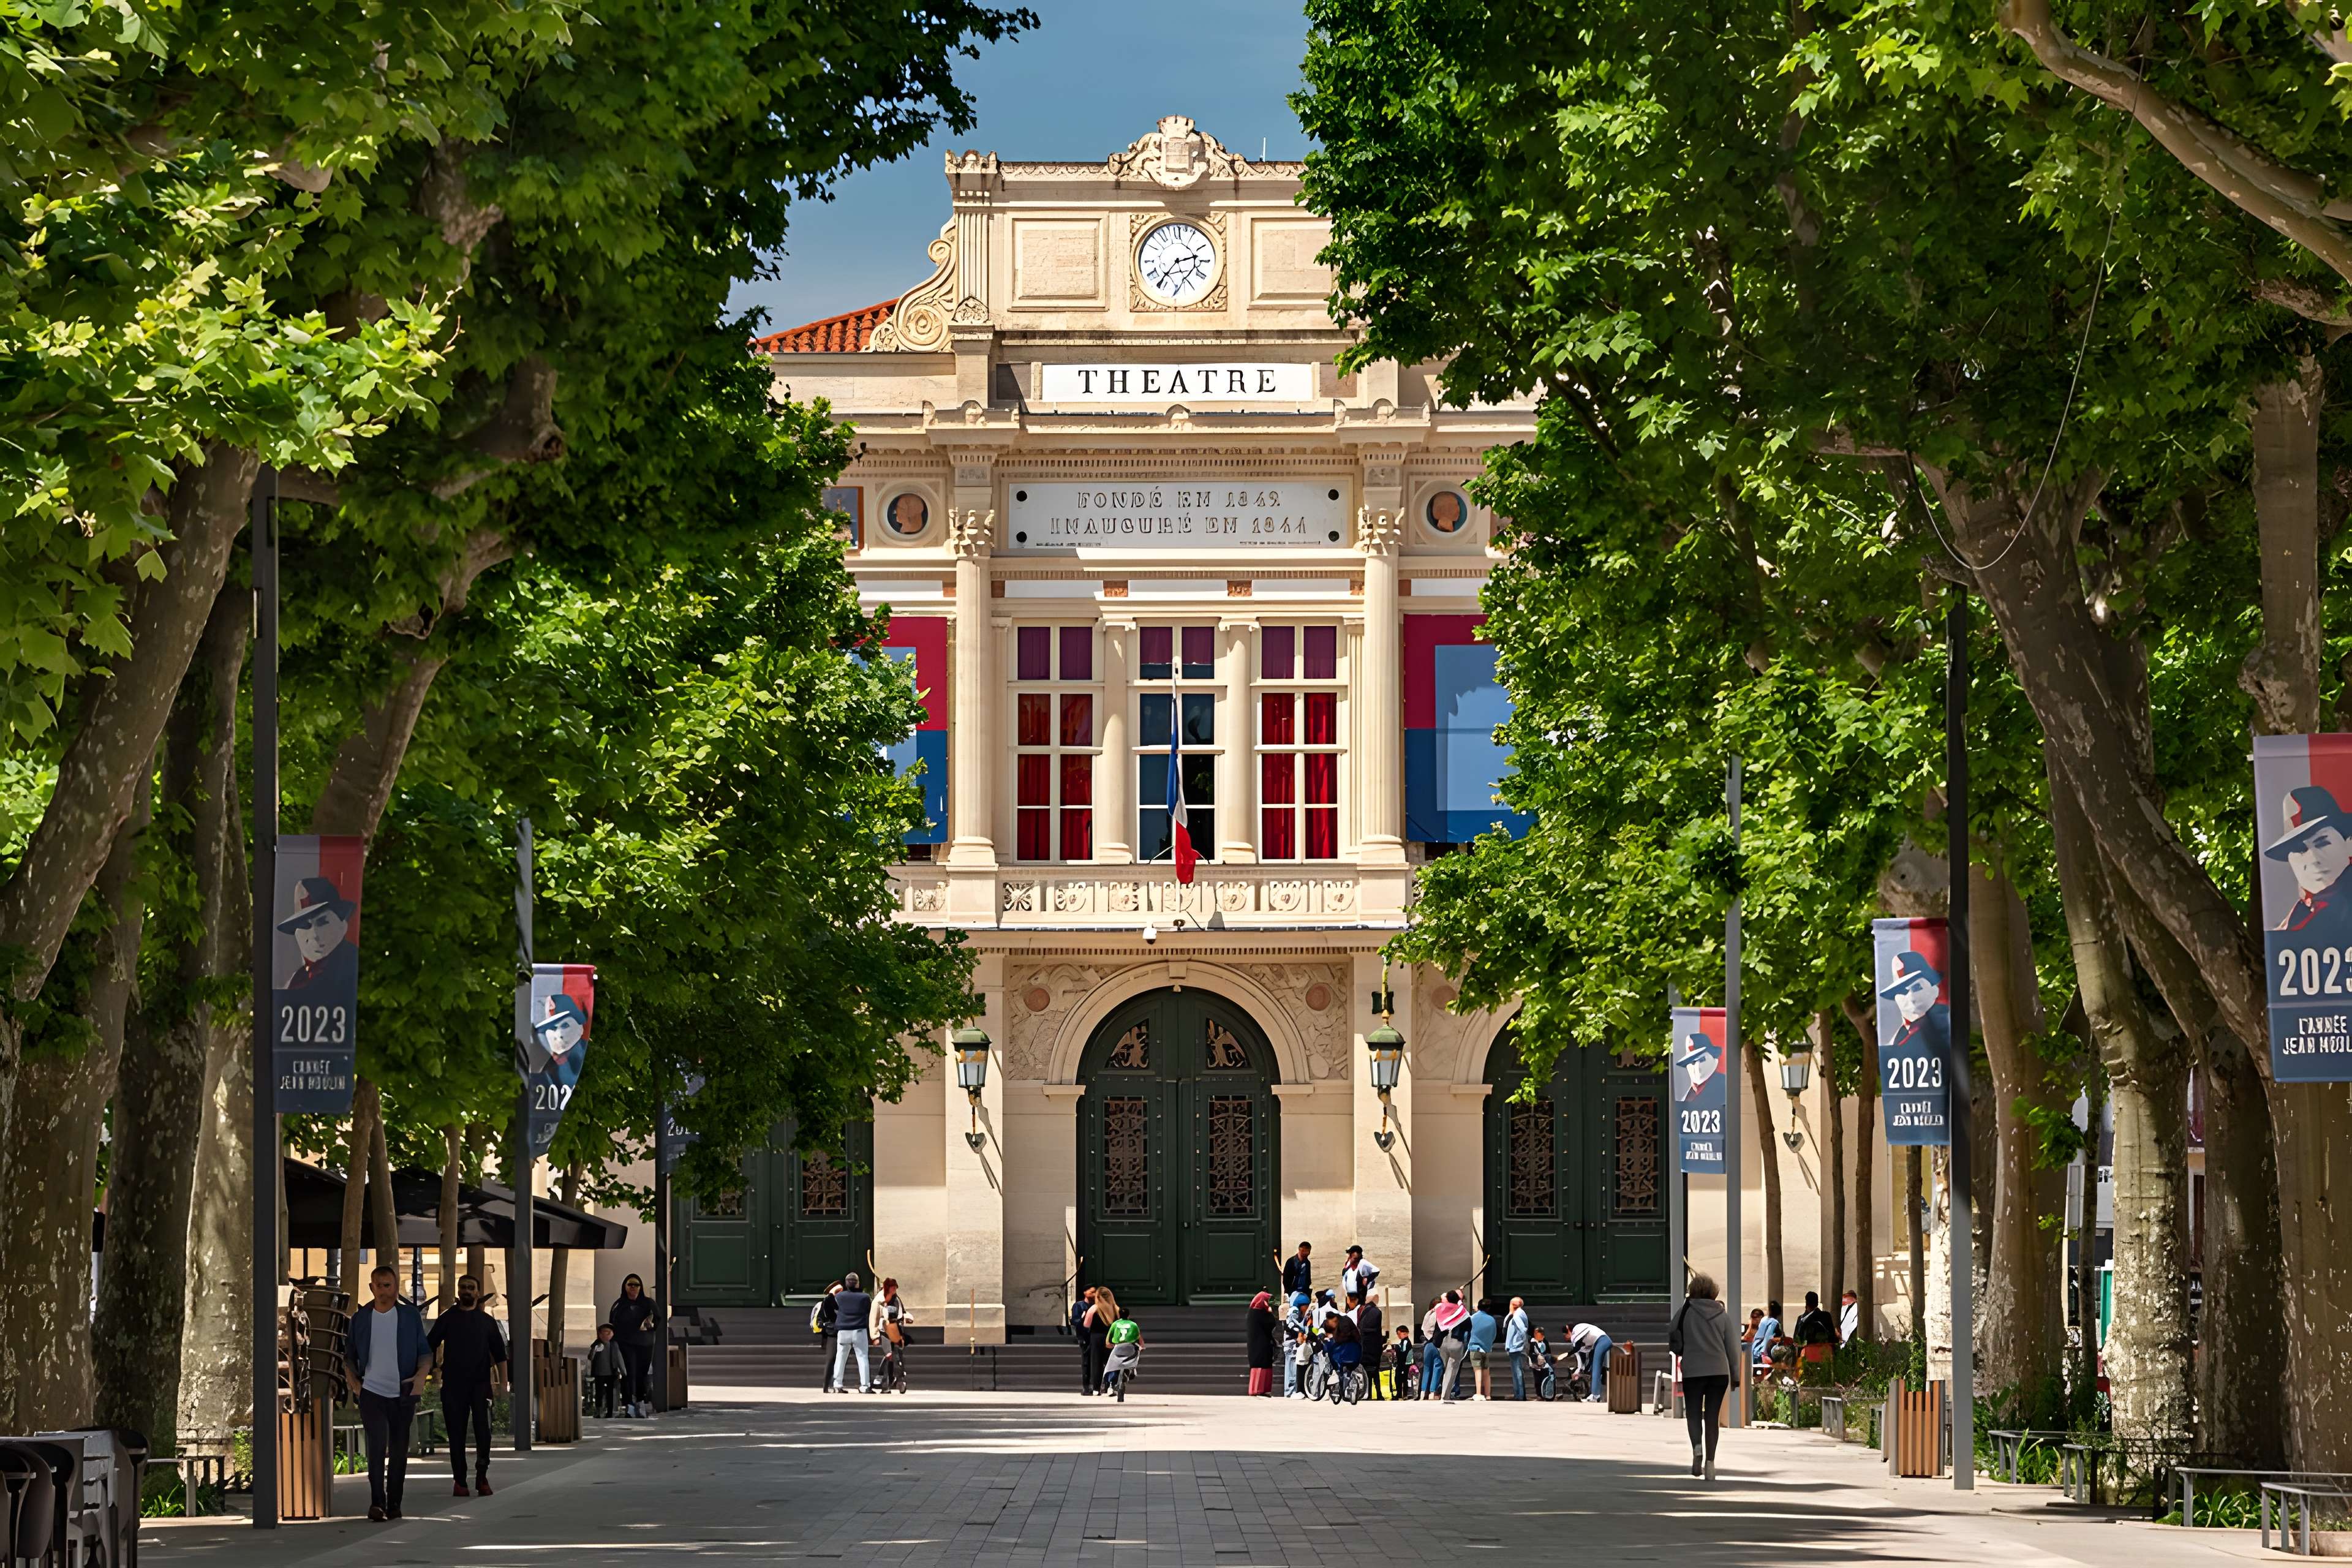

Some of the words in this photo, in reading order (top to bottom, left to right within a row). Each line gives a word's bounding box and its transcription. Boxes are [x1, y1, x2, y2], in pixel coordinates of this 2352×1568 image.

[1077, 369, 1276, 394] THEATRE
[281, 1005, 346, 1043] 2023
[1887, 1057, 1942, 1088] 2023
[1681, 1109, 1721, 1133] 2023
